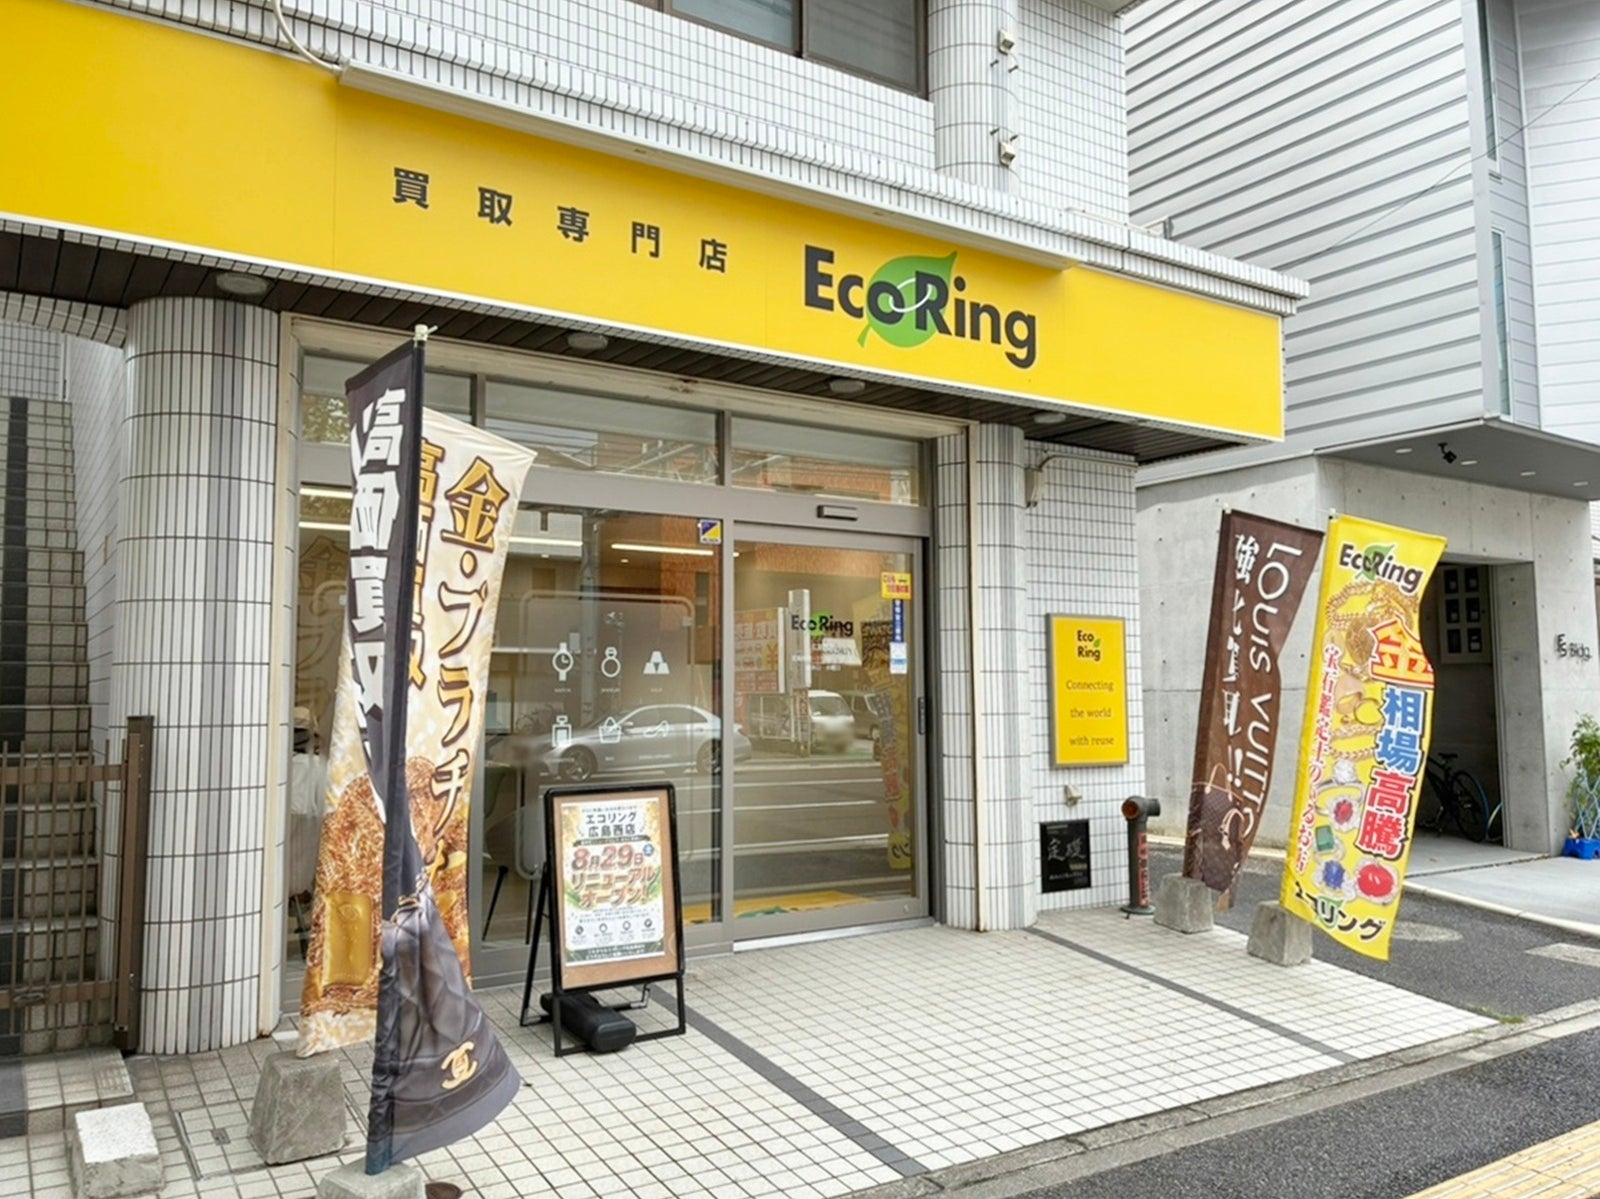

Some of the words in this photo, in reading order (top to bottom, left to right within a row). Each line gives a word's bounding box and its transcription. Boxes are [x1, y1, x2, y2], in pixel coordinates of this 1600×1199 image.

[393, 168, 727, 273] 買取専門店
[804, 245, 1037, 368] EcoRing
[1338, 543, 1424, 594] EcoRing
[1249, 542, 1303, 673] LOUIS
[791, 614, 854, 637] EcoRing
[1077, 629, 1095, 642] Eco
[1077, 646, 1101, 662] Ring
[1066, 680, 1115, 692] Connecting
[1070, 708, 1085, 719] the
[1087, 708, 1112, 718] world
[1069, 735, 1089, 746] with
[1091, 738, 1115, 746] reuse
[1357, 614, 1435, 858] 金相場高騰
[1241, 693, 1272, 840] VUITTO
[586, 811, 637, 825] エコリング
[588, 824, 636, 838] 広島西店
